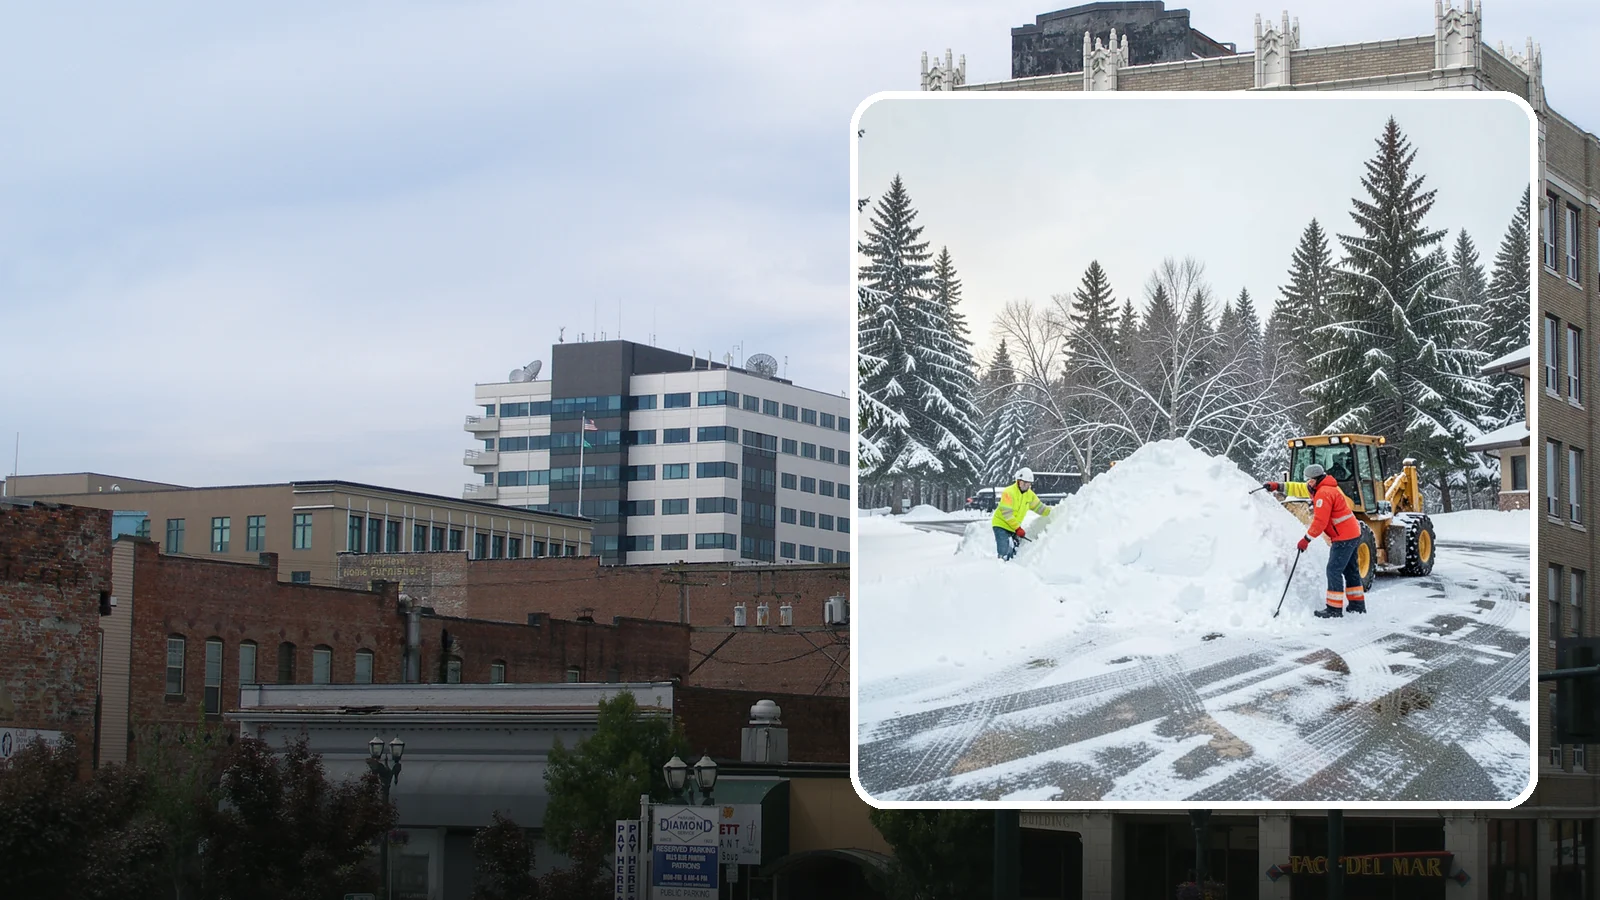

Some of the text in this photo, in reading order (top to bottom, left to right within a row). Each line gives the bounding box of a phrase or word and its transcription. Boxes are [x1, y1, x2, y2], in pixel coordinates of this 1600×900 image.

[343, 566, 427, 577] Home Furnishers
[660, 818, 713, 833] DIAMOND
[1022, 816, 1069, 828] BUILDING
[719, 824, 740, 835] ETT
[719, 839, 740, 848] ANT
[617, 825, 625, 893] PAY HERE
[628, 825, 637, 893] PAY HERE
[722, 851, 739, 861] Soup
[671, 862, 701, 870] PATRONS
[1346, 856, 1384, 875] DEL
[1392, 857, 1442, 876] MAR
[660, 889, 710, 898] PUBLIC PARKING
